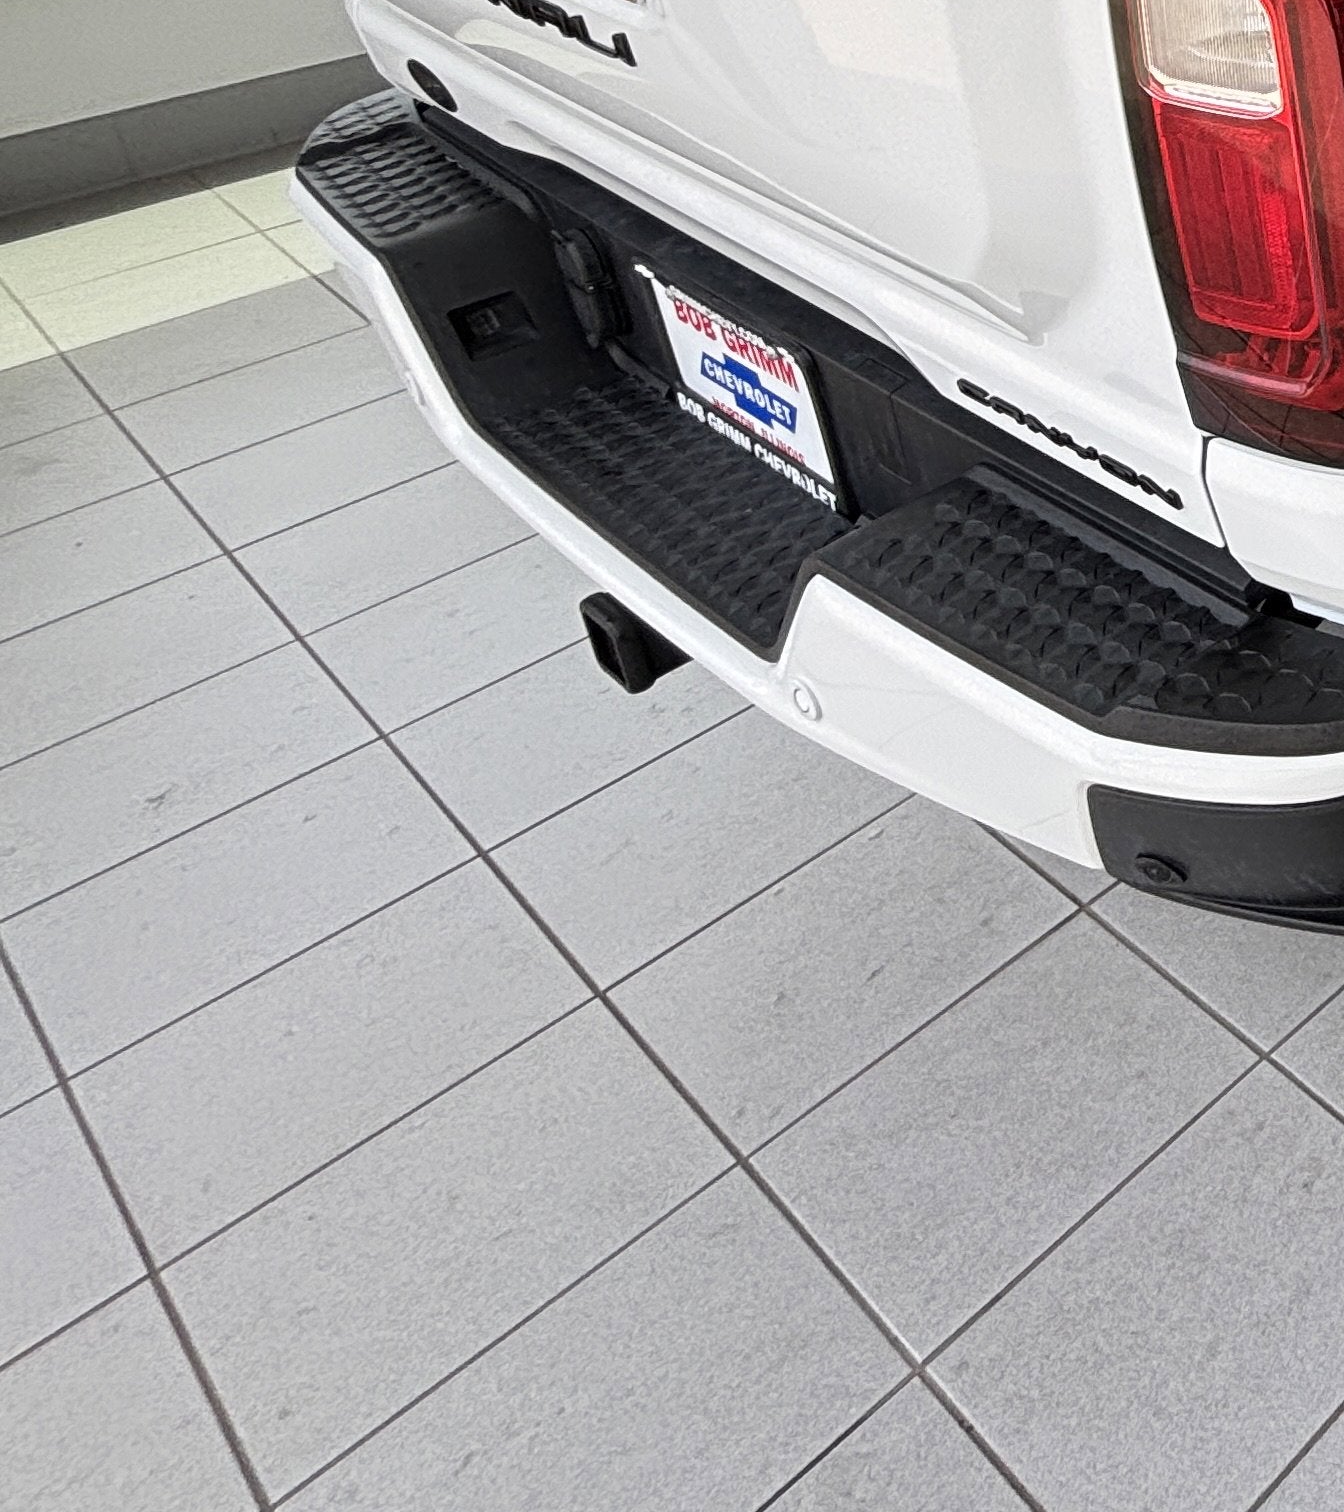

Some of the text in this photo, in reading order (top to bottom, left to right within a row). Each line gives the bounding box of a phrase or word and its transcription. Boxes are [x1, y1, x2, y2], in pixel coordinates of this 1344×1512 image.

[673, 297, 718, 341] BOB
[720, 325, 800, 393] GRIMM
[703, 356, 793, 427] CHEVROLET
[676, 391, 838, 512] BOB GRIMM CHEVROLET
[955, 376, 1184, 510] CANYON
